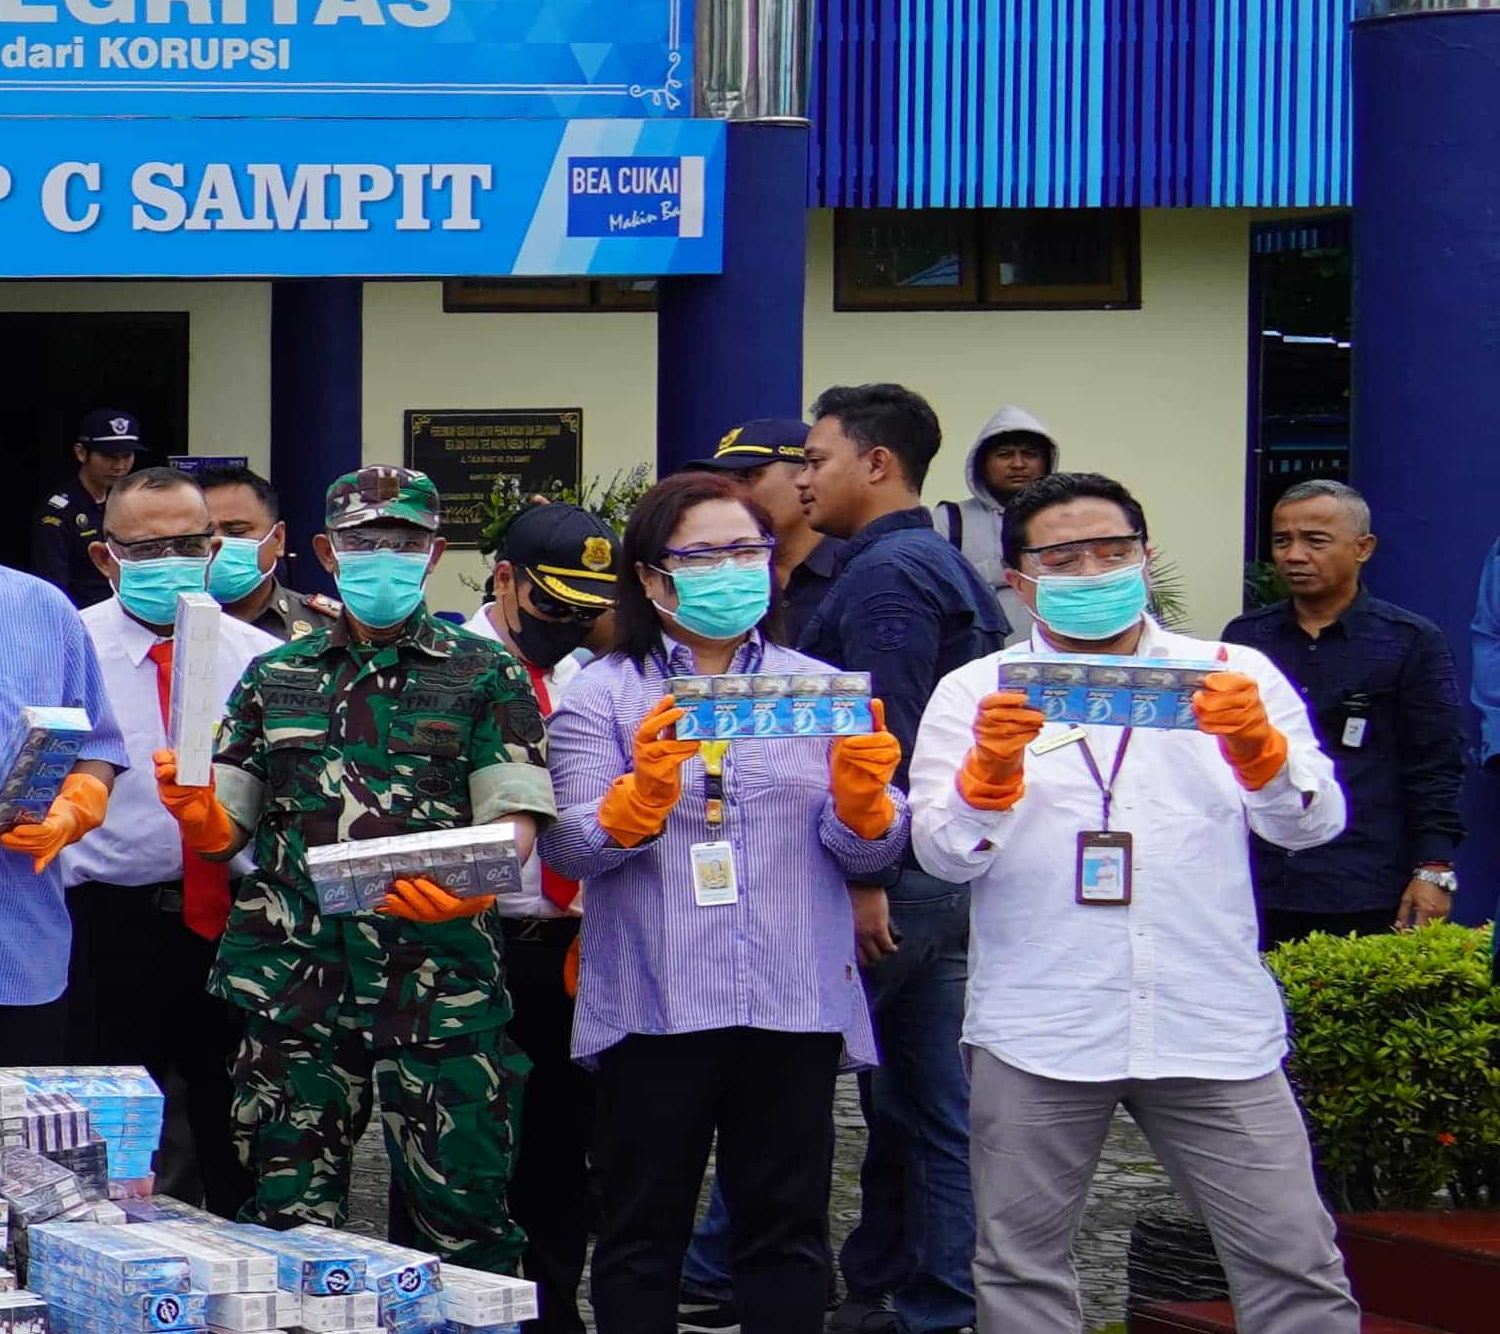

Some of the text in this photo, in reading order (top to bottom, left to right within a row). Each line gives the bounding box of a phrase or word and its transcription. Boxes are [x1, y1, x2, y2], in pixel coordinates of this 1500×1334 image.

[1, 35, 85, 69] dari
[99, 36, 291, 72] KORUPSI
[572, 167, 679, 195] BEA CUKAI
[41, 161, 102, 235] C
[132, 161, 492, 234] SAMPIT
[608, 210, 658, 233] Makin
